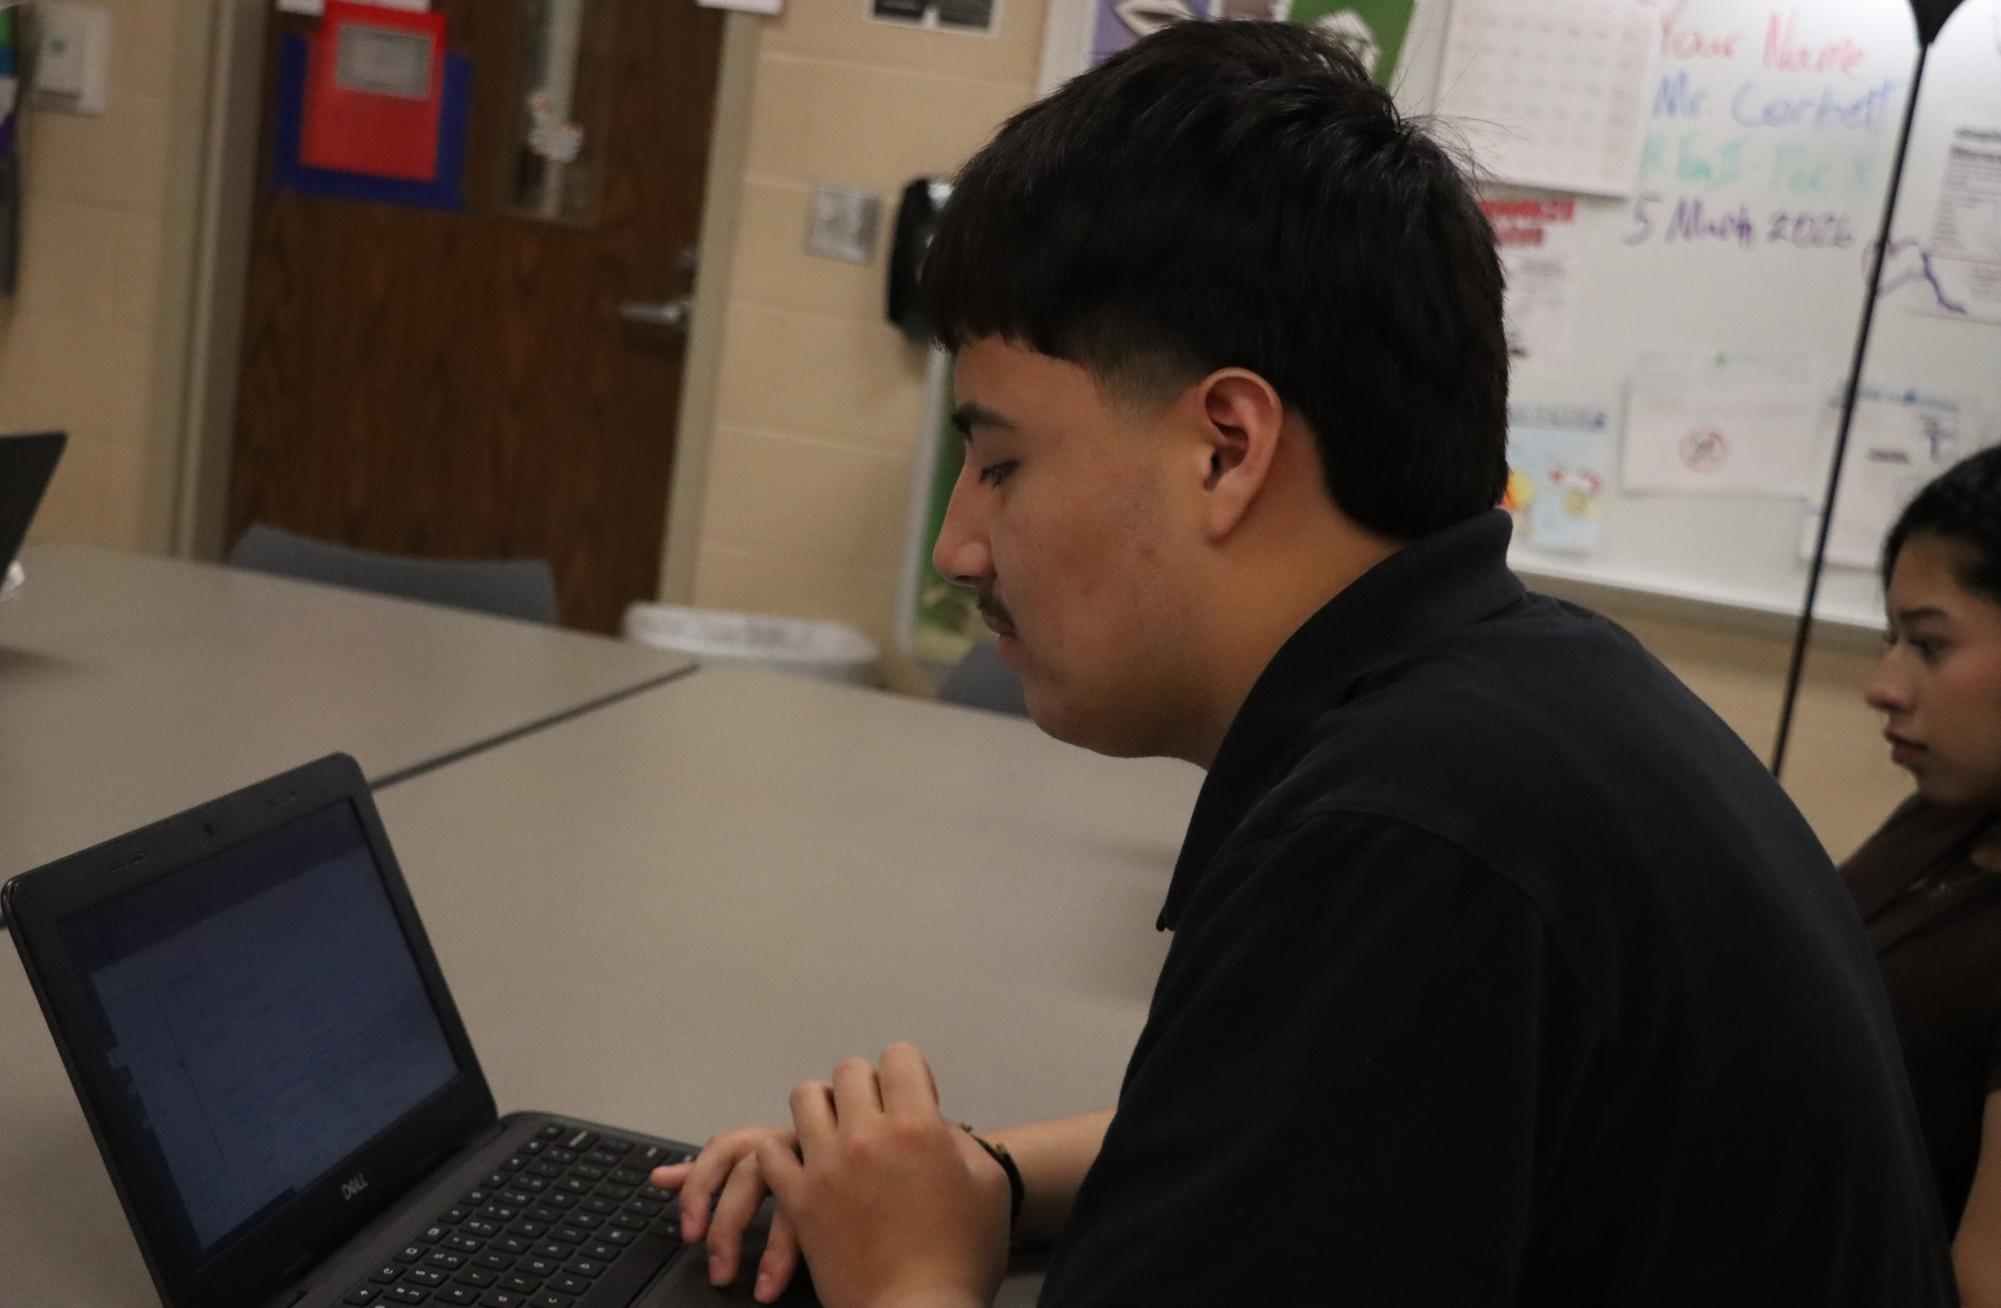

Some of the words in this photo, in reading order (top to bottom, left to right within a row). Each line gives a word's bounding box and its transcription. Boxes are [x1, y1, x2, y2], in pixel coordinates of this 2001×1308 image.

[1659, 0, 1743, 60] Your
[1762, 9, 1867, 79] Name
[1620, 193, 1663, 246] 5
[342, 1172, 369, 1200] DELL
